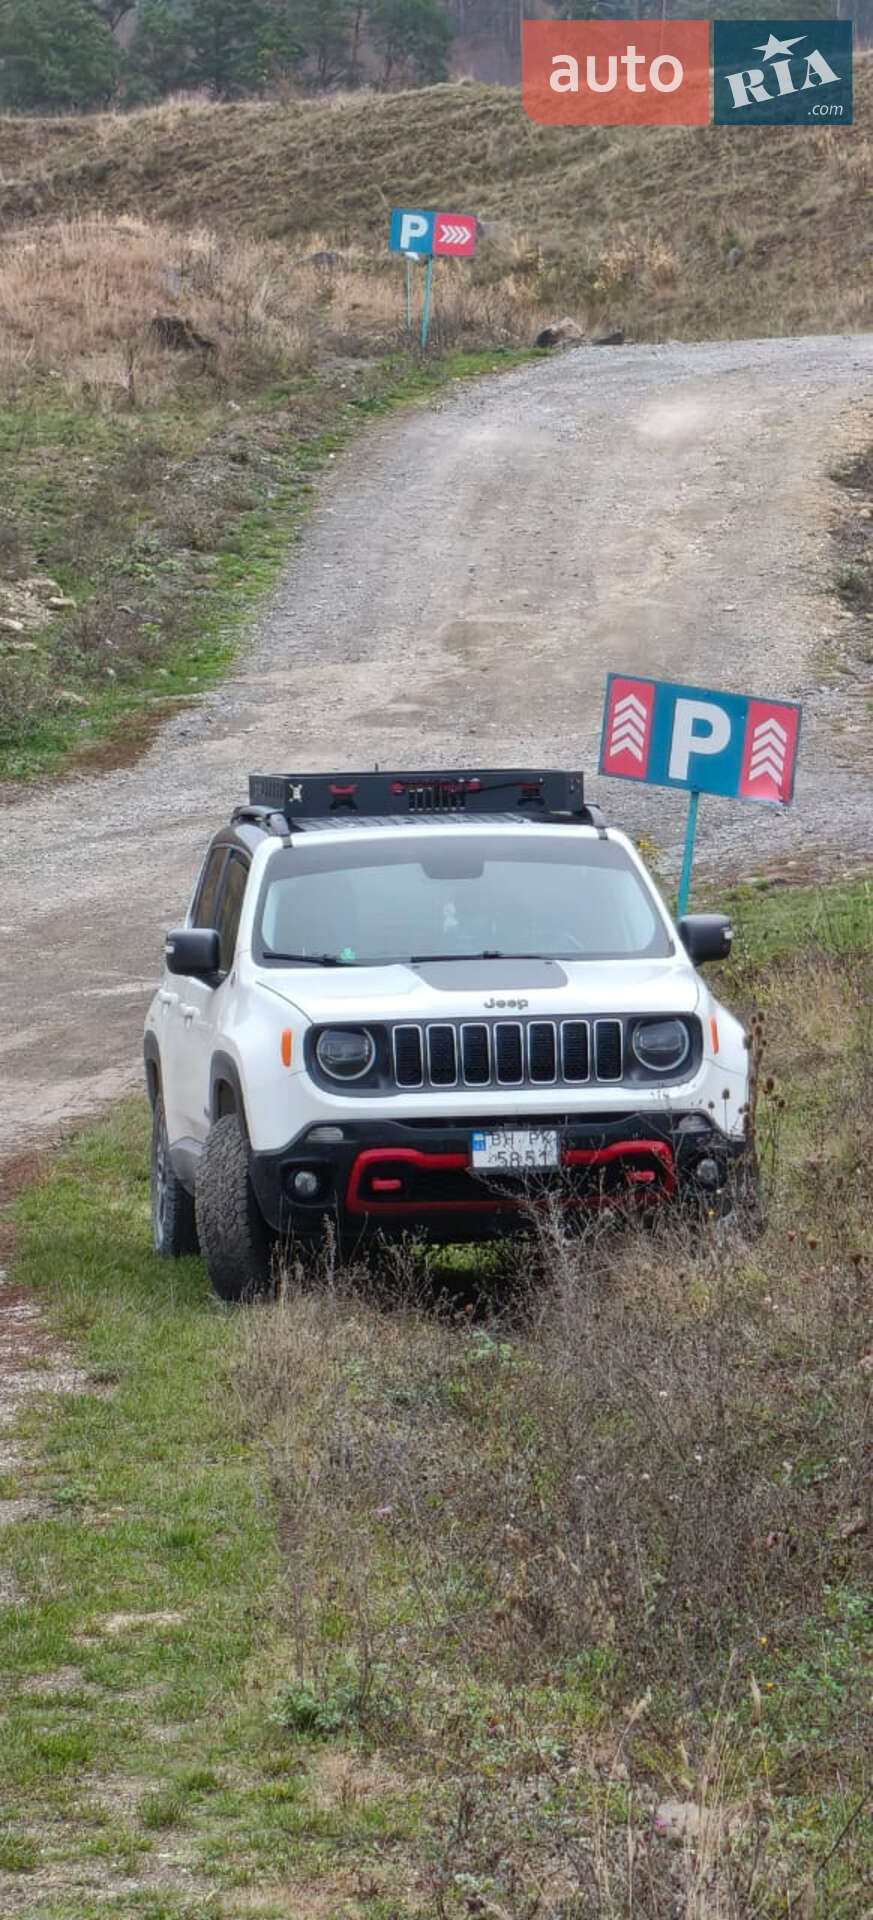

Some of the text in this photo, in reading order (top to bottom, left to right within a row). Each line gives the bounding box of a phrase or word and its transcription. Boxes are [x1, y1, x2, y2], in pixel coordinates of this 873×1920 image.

[400, 214, 429, 249] P
[668, 698, 731, 781] P
[483, 998, 529, 1010] Jeep
[496, 1151, 549, 1168] 5851
